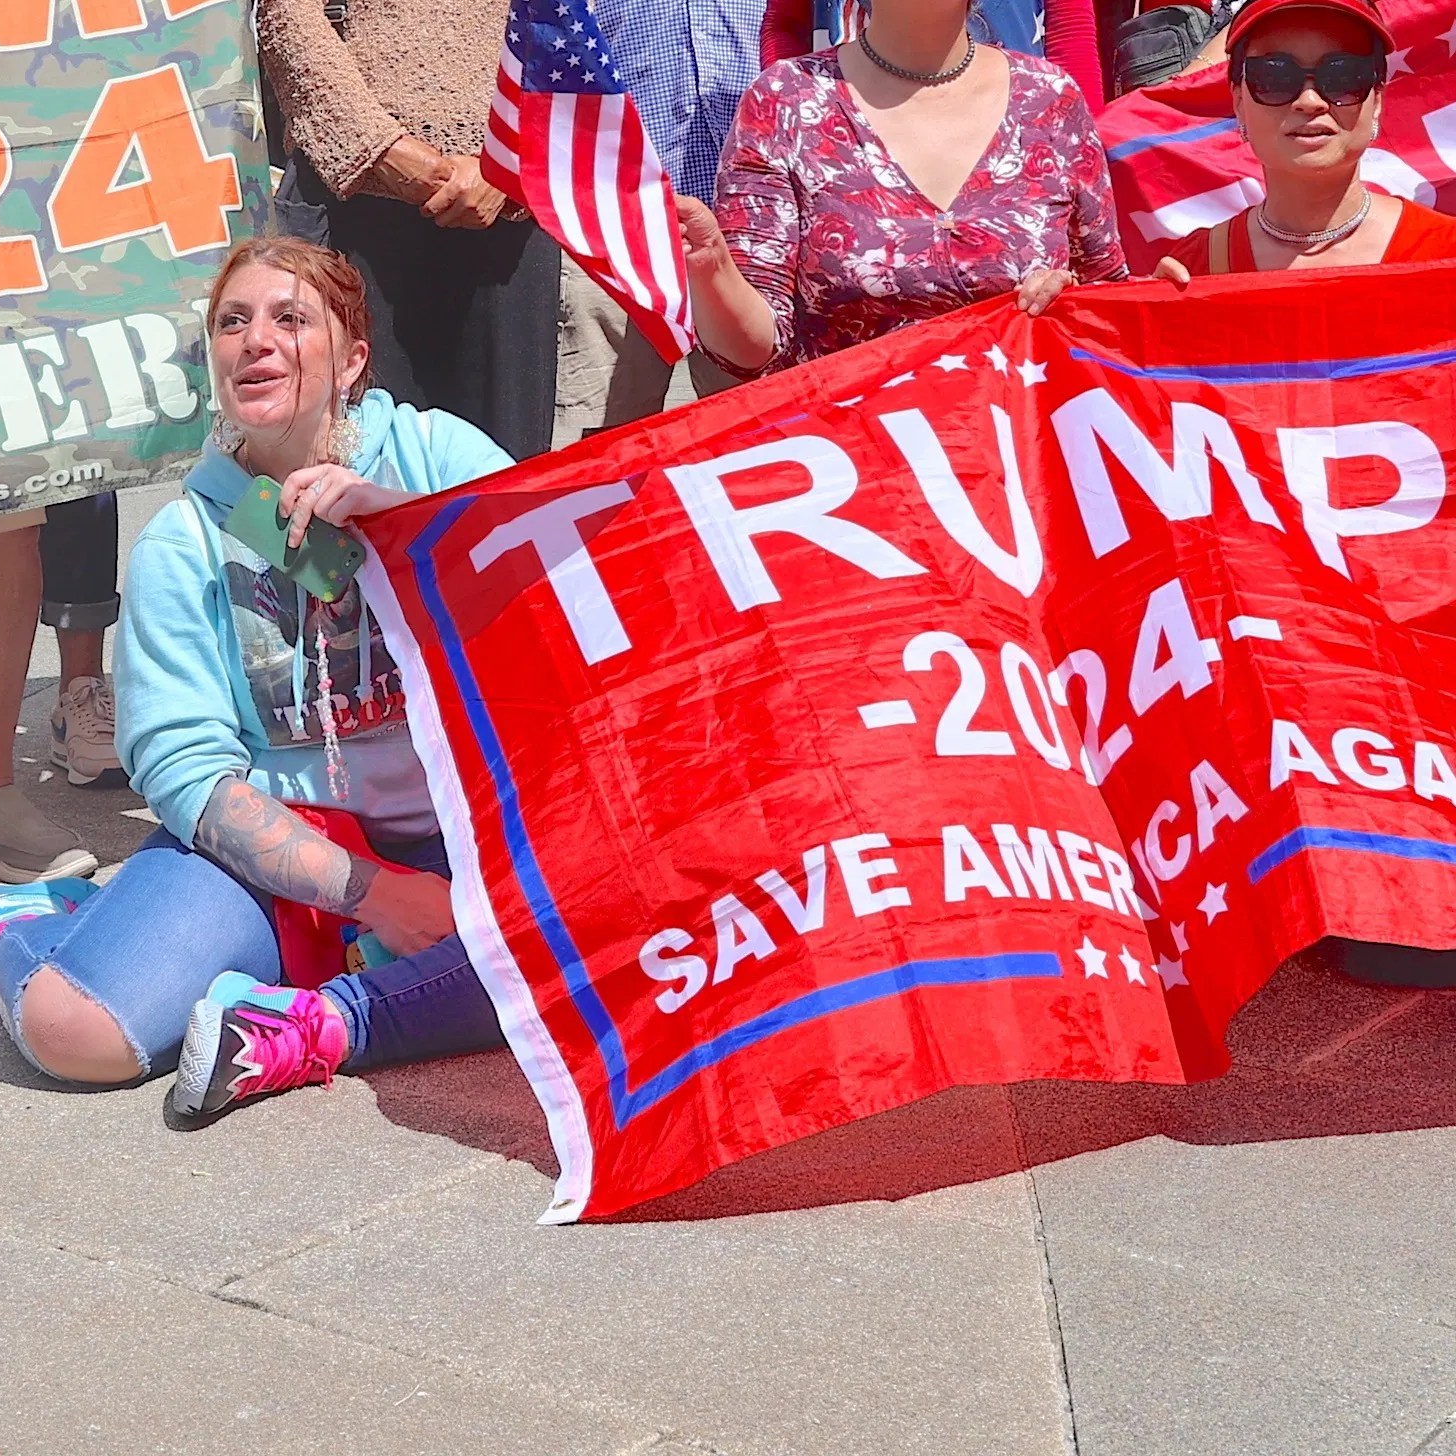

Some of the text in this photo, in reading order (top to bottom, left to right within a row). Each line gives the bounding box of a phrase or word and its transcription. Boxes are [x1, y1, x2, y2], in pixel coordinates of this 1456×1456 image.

[468, 387, 1447, 667] TRUMP
[637, 832, 913, 1015] SAVE
[944, 759, 1249, 922] AMERICA
